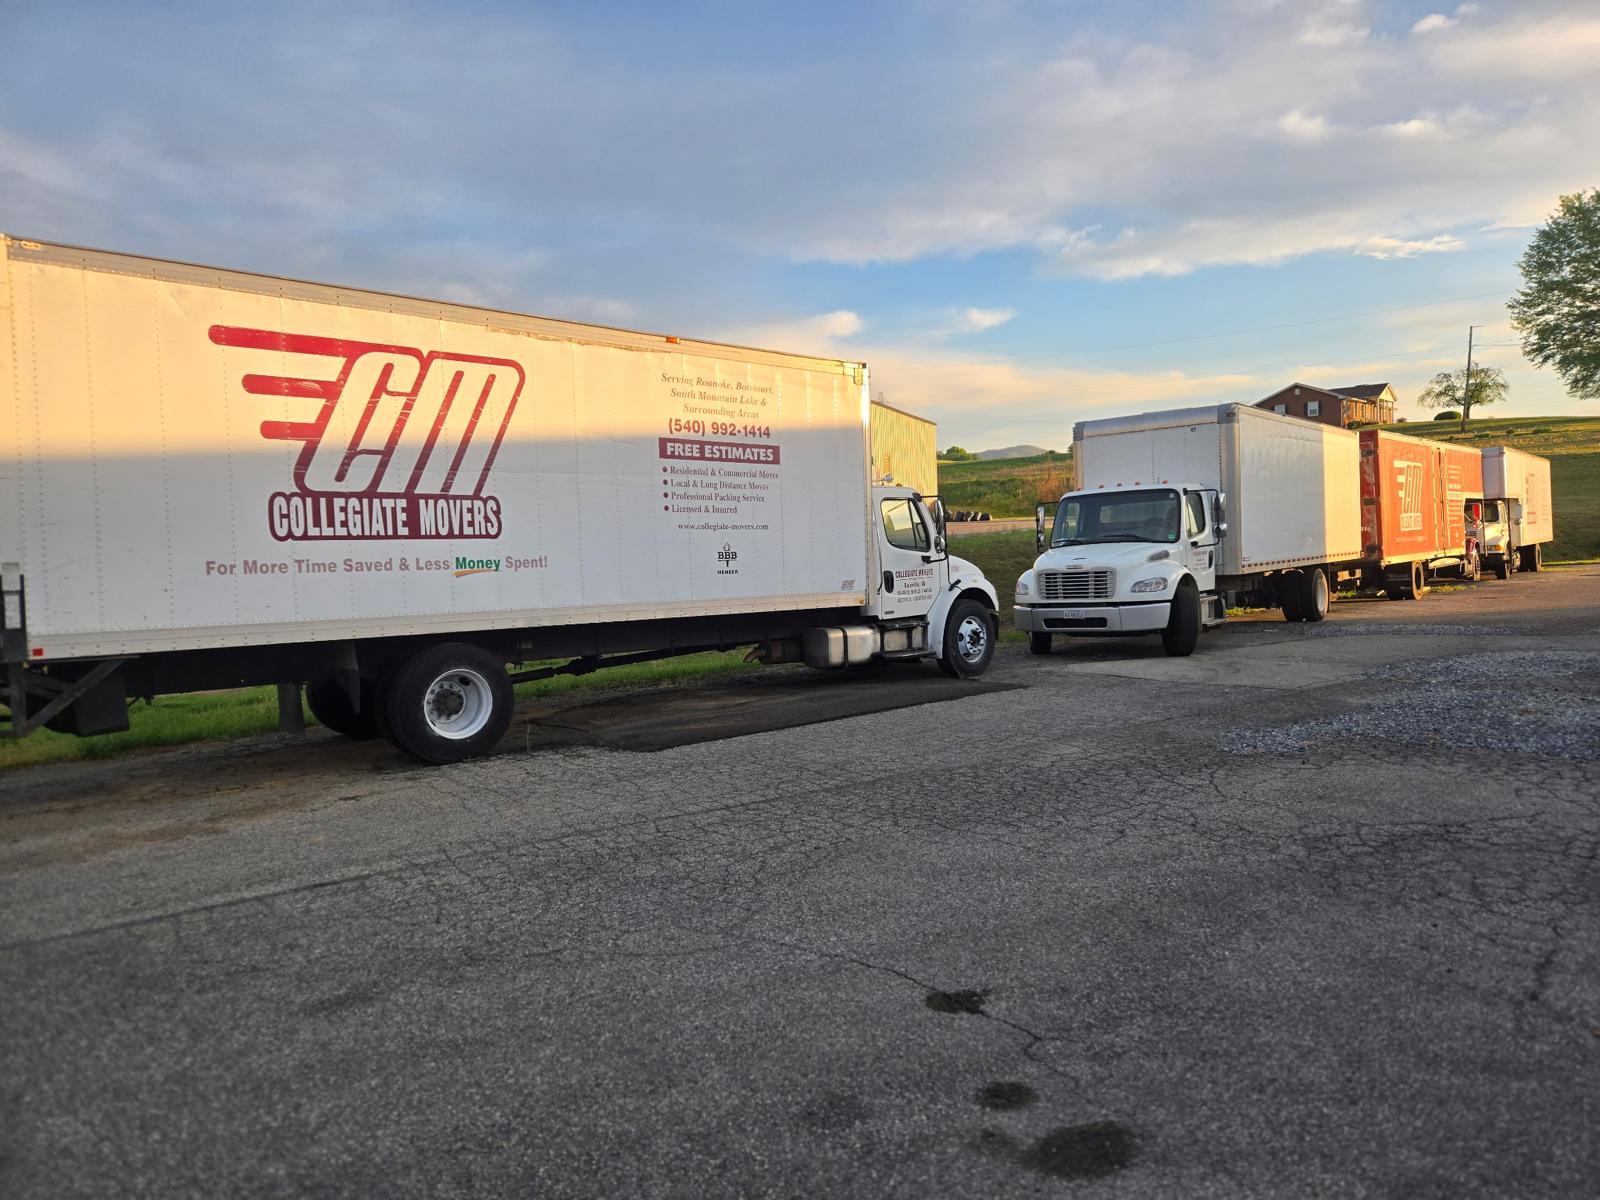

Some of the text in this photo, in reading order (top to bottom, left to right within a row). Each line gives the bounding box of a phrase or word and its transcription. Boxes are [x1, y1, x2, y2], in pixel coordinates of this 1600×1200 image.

[661, 373, 694, 386] Serving
[696, 377, 734, 391] Roanoke,
[671, 388, 767, 407] Smith Mountain Lake &
[683, 403, 759, 419] Surrounding Areas
[669, 418, 706, 437] (540)
[666, 442, 774, 461] FREE ESTIMATES
[670, 466, 779, 480] Residential & Commercial Moves
[670, 479, 769, 491] Local & Long Distance Moves
[671, 492, 765, 503] Professional Packing Service
[273, 496, 500, 538] COLLEGIATE MOVERS
[672, 504, 738, 514] Licensed & Insured
[678, 522, 769, 532] www.collegiate-movers.com
[717, 551, 738, 560] BBB
[205, 555, 548, 576] For More Time Saved & Less Money Spent!
